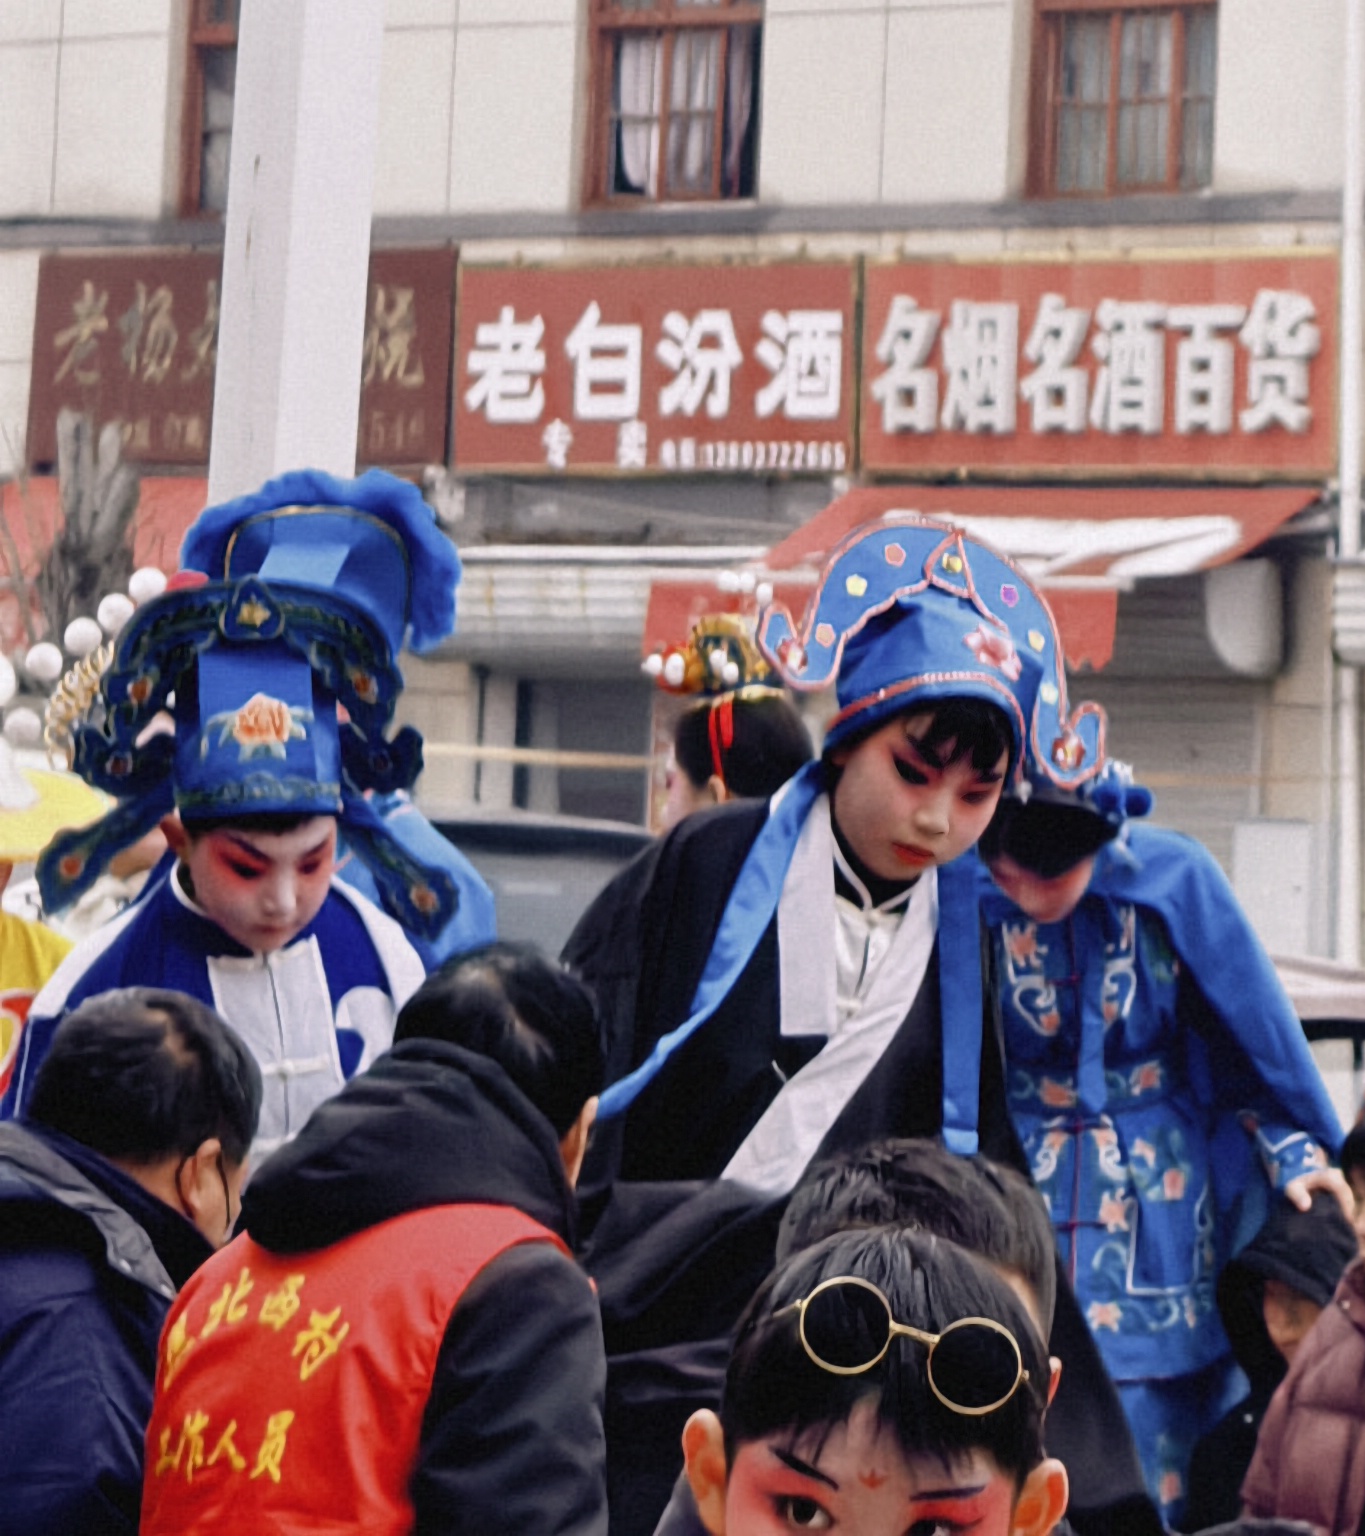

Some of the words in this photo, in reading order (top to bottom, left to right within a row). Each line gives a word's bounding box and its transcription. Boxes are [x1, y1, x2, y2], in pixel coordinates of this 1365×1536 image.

[465, 300, 844, 424] 老白汾酒
[871, 288, 1320, 434] 名烟名酒百货
